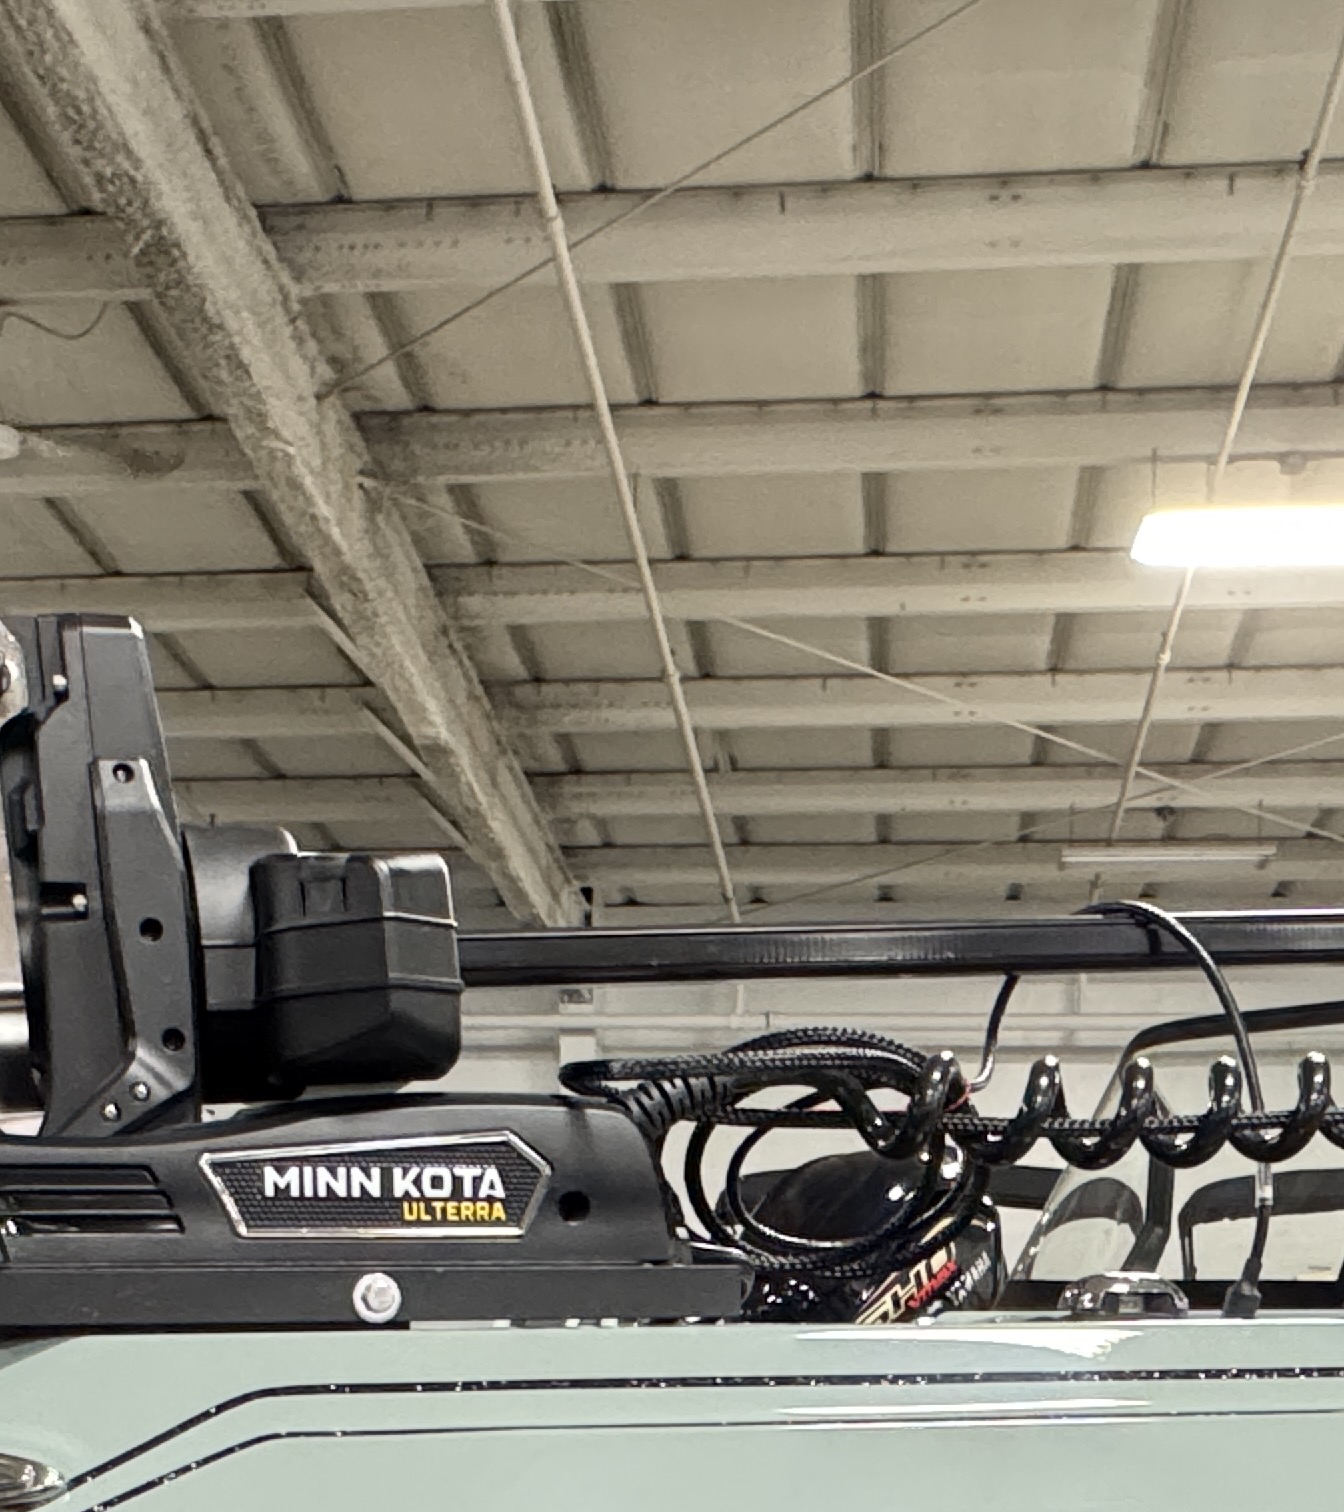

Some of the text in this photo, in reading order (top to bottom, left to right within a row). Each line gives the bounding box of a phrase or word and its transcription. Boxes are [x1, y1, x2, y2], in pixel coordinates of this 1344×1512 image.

[262, 1164, 506, 1199] MINN KOTA
[402, 1200, 506, 1223] ULTERRA
